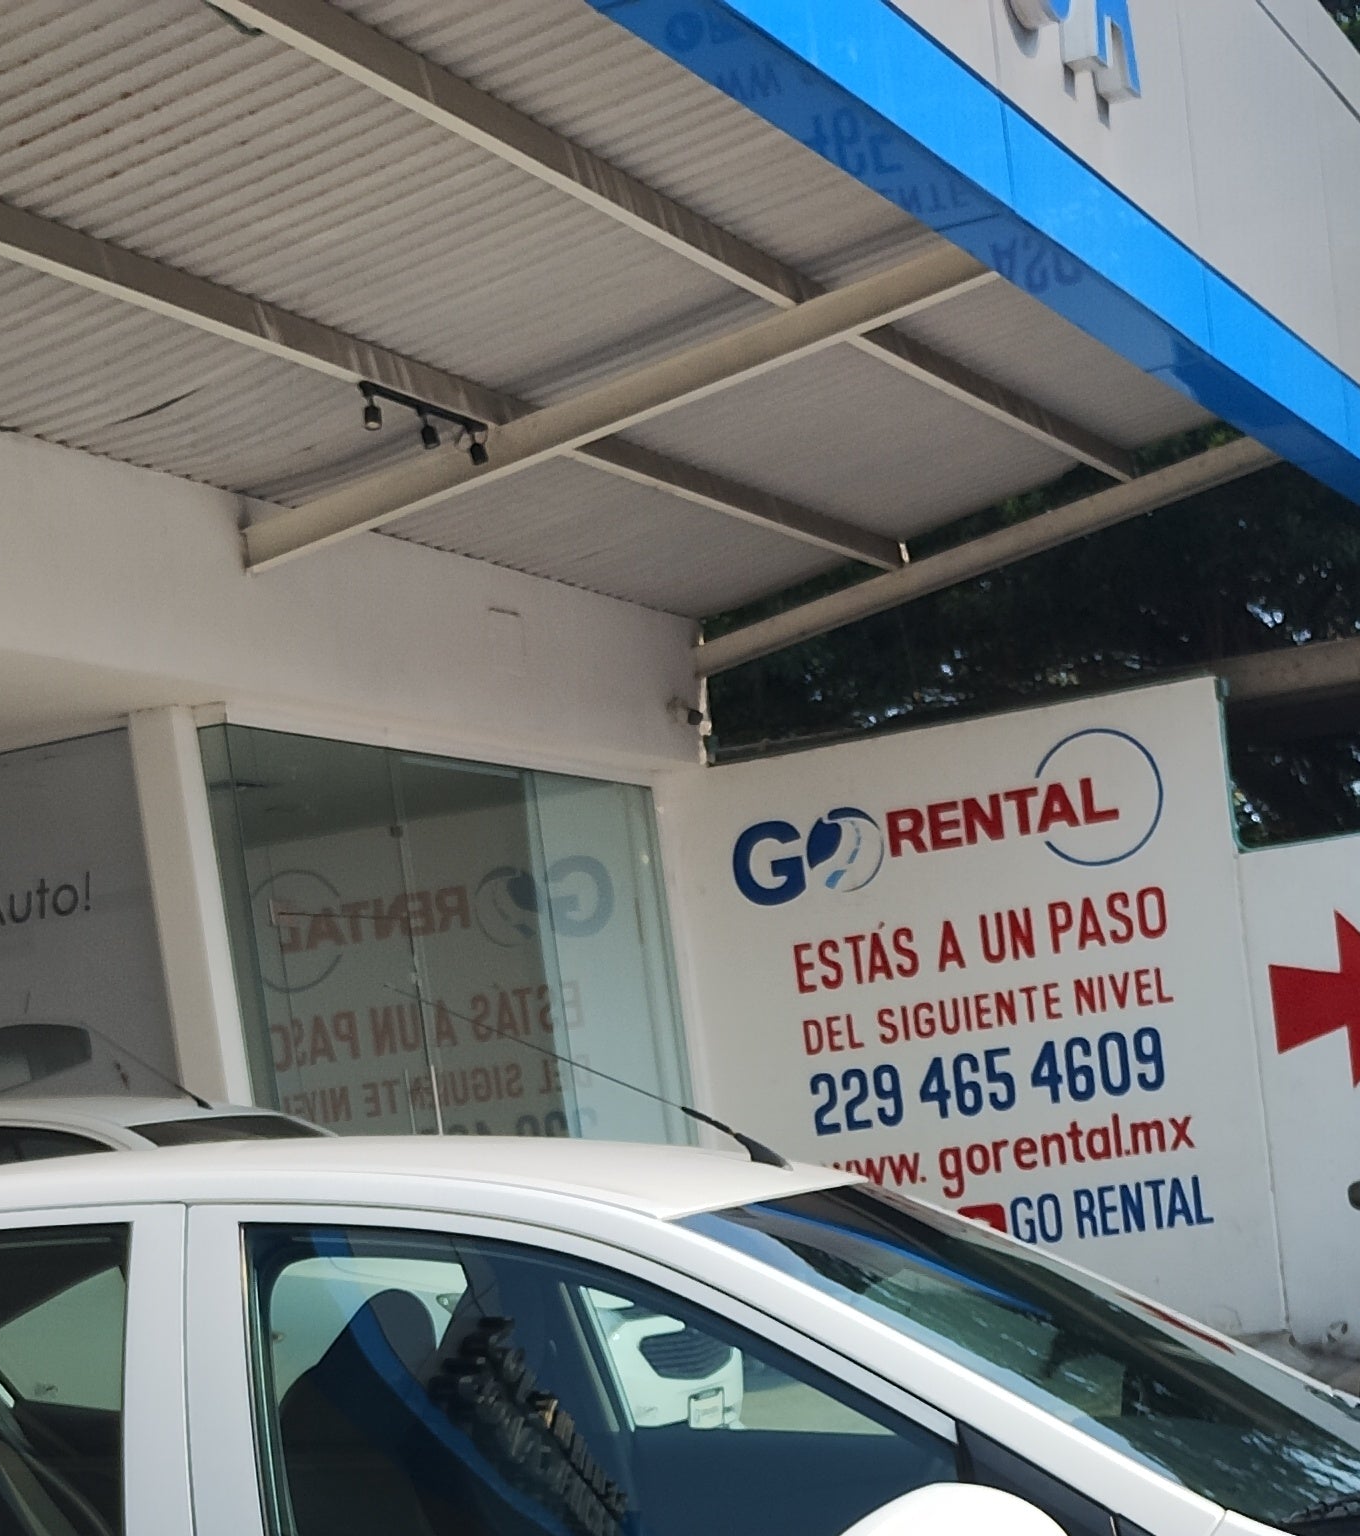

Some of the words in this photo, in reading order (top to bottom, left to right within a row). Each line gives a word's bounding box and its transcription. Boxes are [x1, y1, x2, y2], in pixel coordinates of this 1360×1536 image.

[886, 777, 1119, 857] RENTAL
[793, 921, 920, 994] ESTÁS
[938, 920, 966, 972] A
[979, 907, 1036, 965] UN
[1048, 886, 1168, 954] PASO
[803, 1014, 865, 1056] DEL
[878, 982, 1063, 1045] SIGUIENTE
[1074, 967, 1174, 1015] NIVEL
[810, 1064, 904, 1136] 229
[919, 1047, 1016, 1119] 465
[1031, 1026, 1166, 1102] 4609
[939, 1113, 1197, 1199] gorental.mx
[1010, 1192, 1063, 1245] GO
[1073, 1174, 1215, 1239] RENTAL
